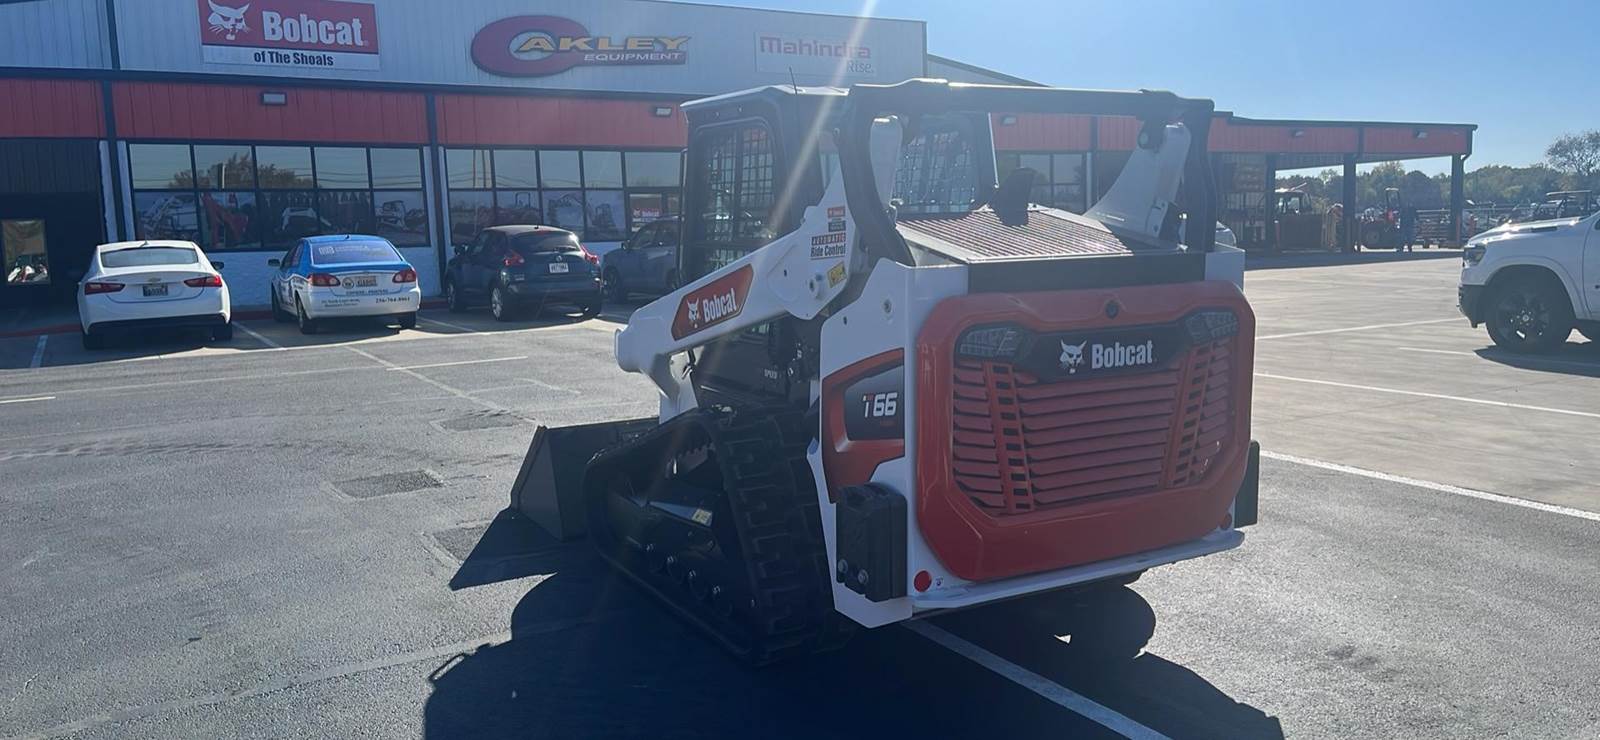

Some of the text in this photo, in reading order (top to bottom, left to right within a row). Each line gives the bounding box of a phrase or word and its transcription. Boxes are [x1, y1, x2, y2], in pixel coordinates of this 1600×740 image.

[262, 10, 364, 46] Bobcat
[253, 51, 334, 66] of The Shoals
[583, 52, 683, 61] EQUIPMENT
[759, 36, 871, 59] Mahindra
[825, 243, 846, 256] Control
[702, 287, 737, 323] Bobcat
[1091, 340, 1153, 369] Bobcat
[862, 392, 898, 418] T66
